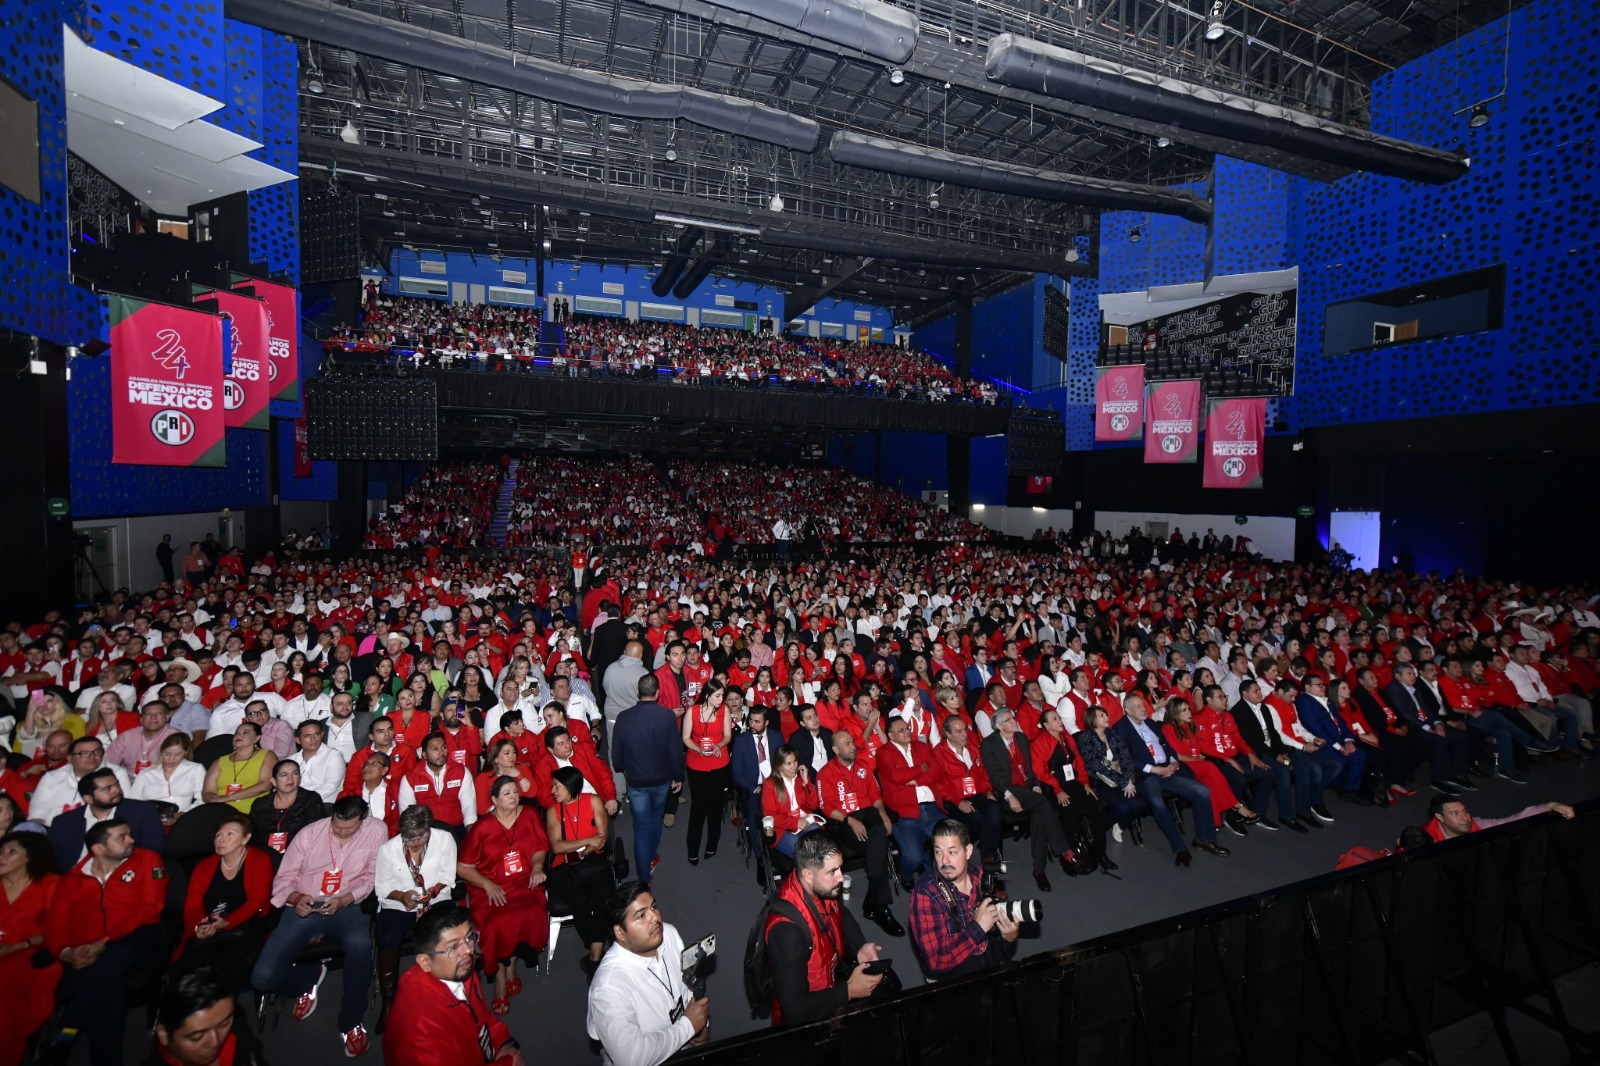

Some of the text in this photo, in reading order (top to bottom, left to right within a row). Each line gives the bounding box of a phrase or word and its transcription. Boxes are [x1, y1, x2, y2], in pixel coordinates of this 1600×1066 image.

[152, 329, 191, 378] 24
[128, 380, 213, 398] DEFENDAMOS
[128, 389, 213, 411] MEXICO
[156, 416, 187, 436] PRI
[1152, 426, 1192, 434] MEXICO
[1213, 447, 1257, 456] MEXICO
[939, 881, 951, 902] Canon
